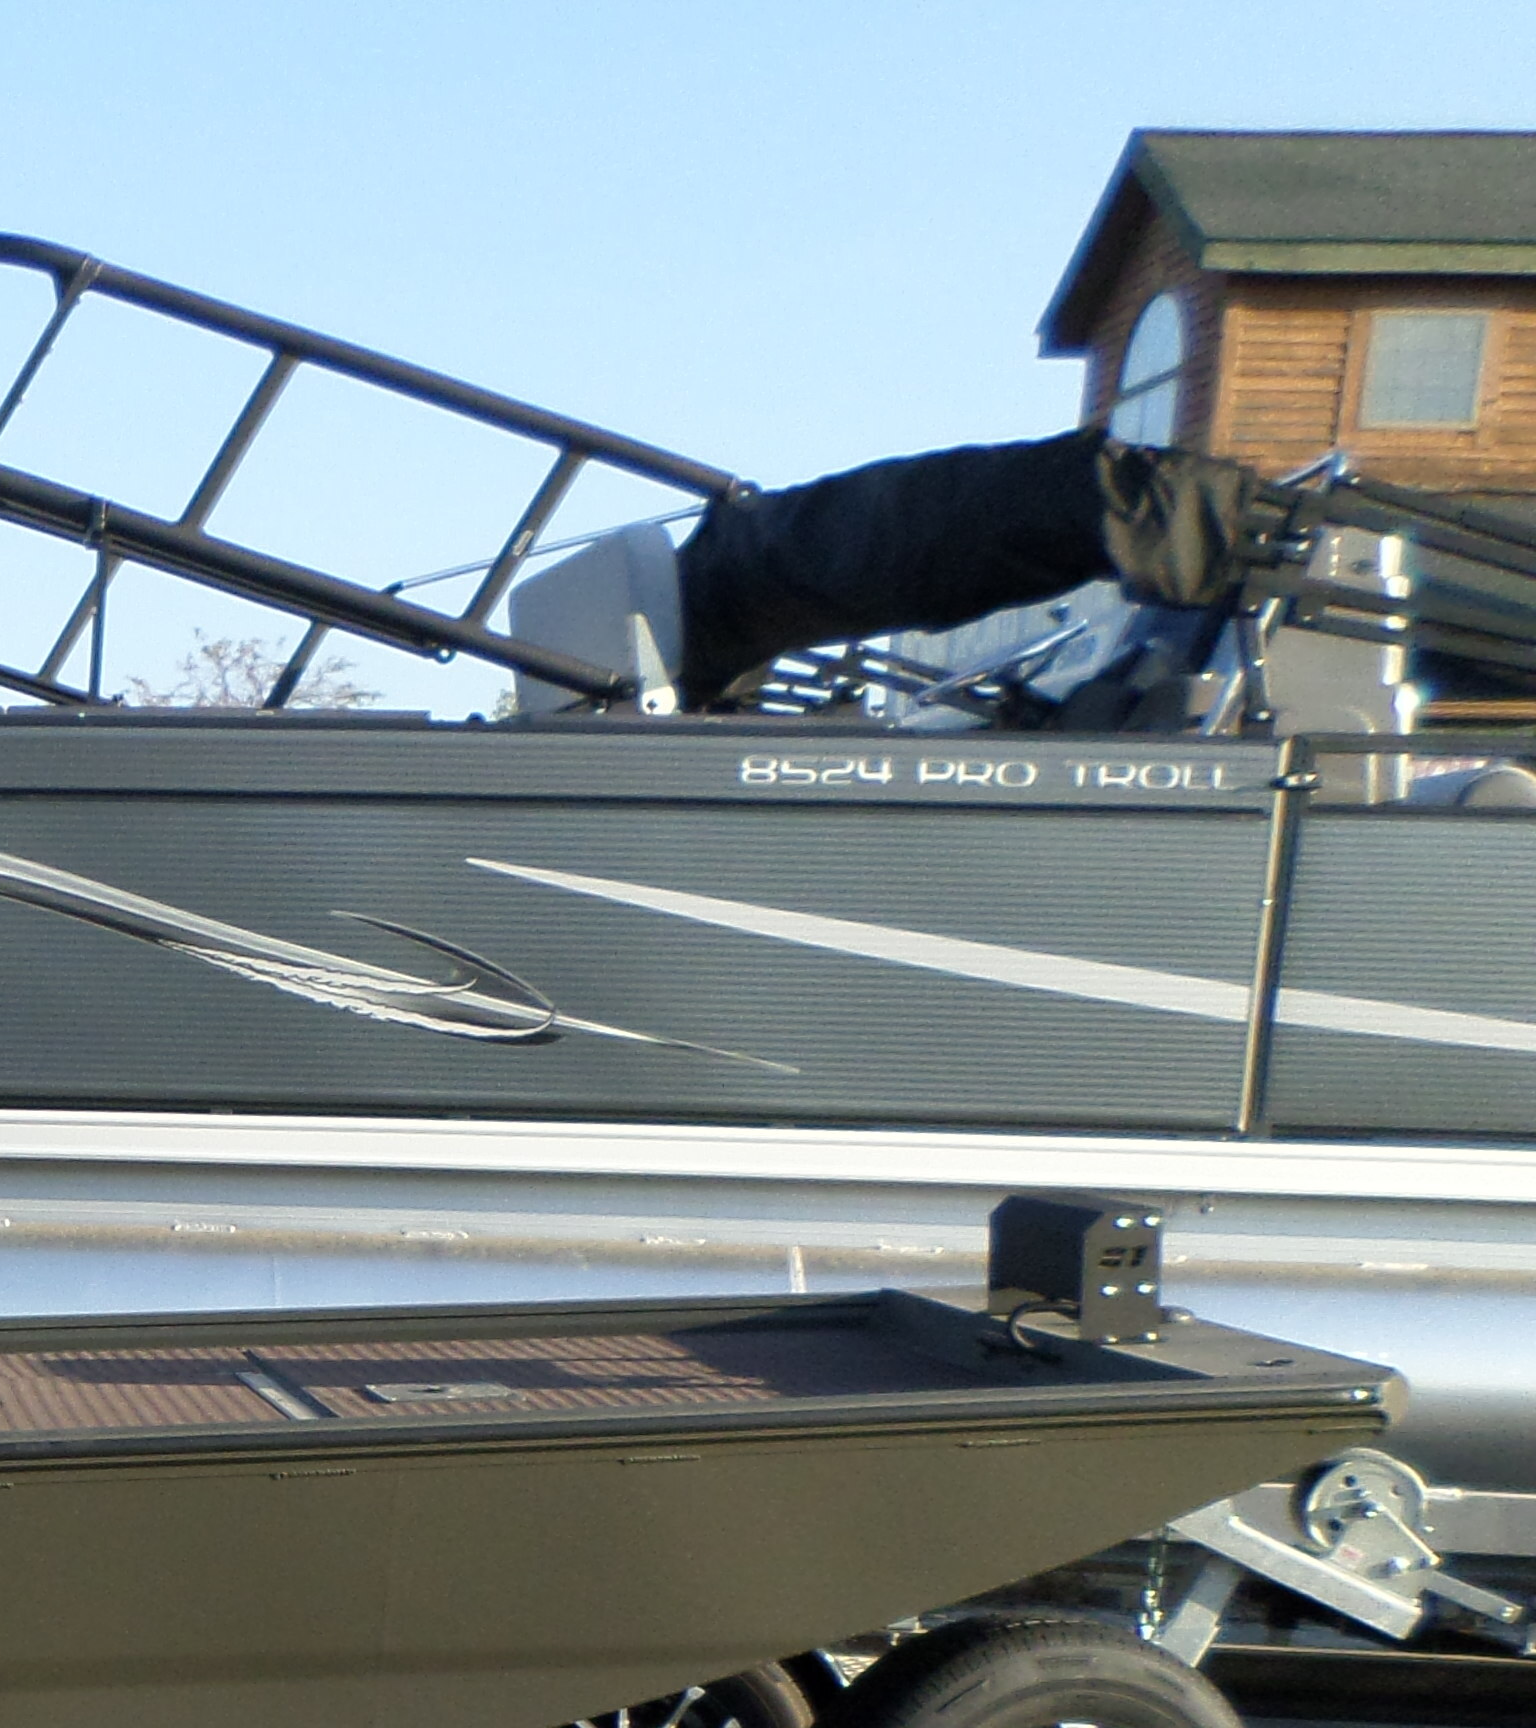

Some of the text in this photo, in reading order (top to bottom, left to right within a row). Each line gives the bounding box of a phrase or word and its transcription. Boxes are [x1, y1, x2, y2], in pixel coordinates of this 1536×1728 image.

[740, 754, 1237, 791] 8524 PRO TROLL
